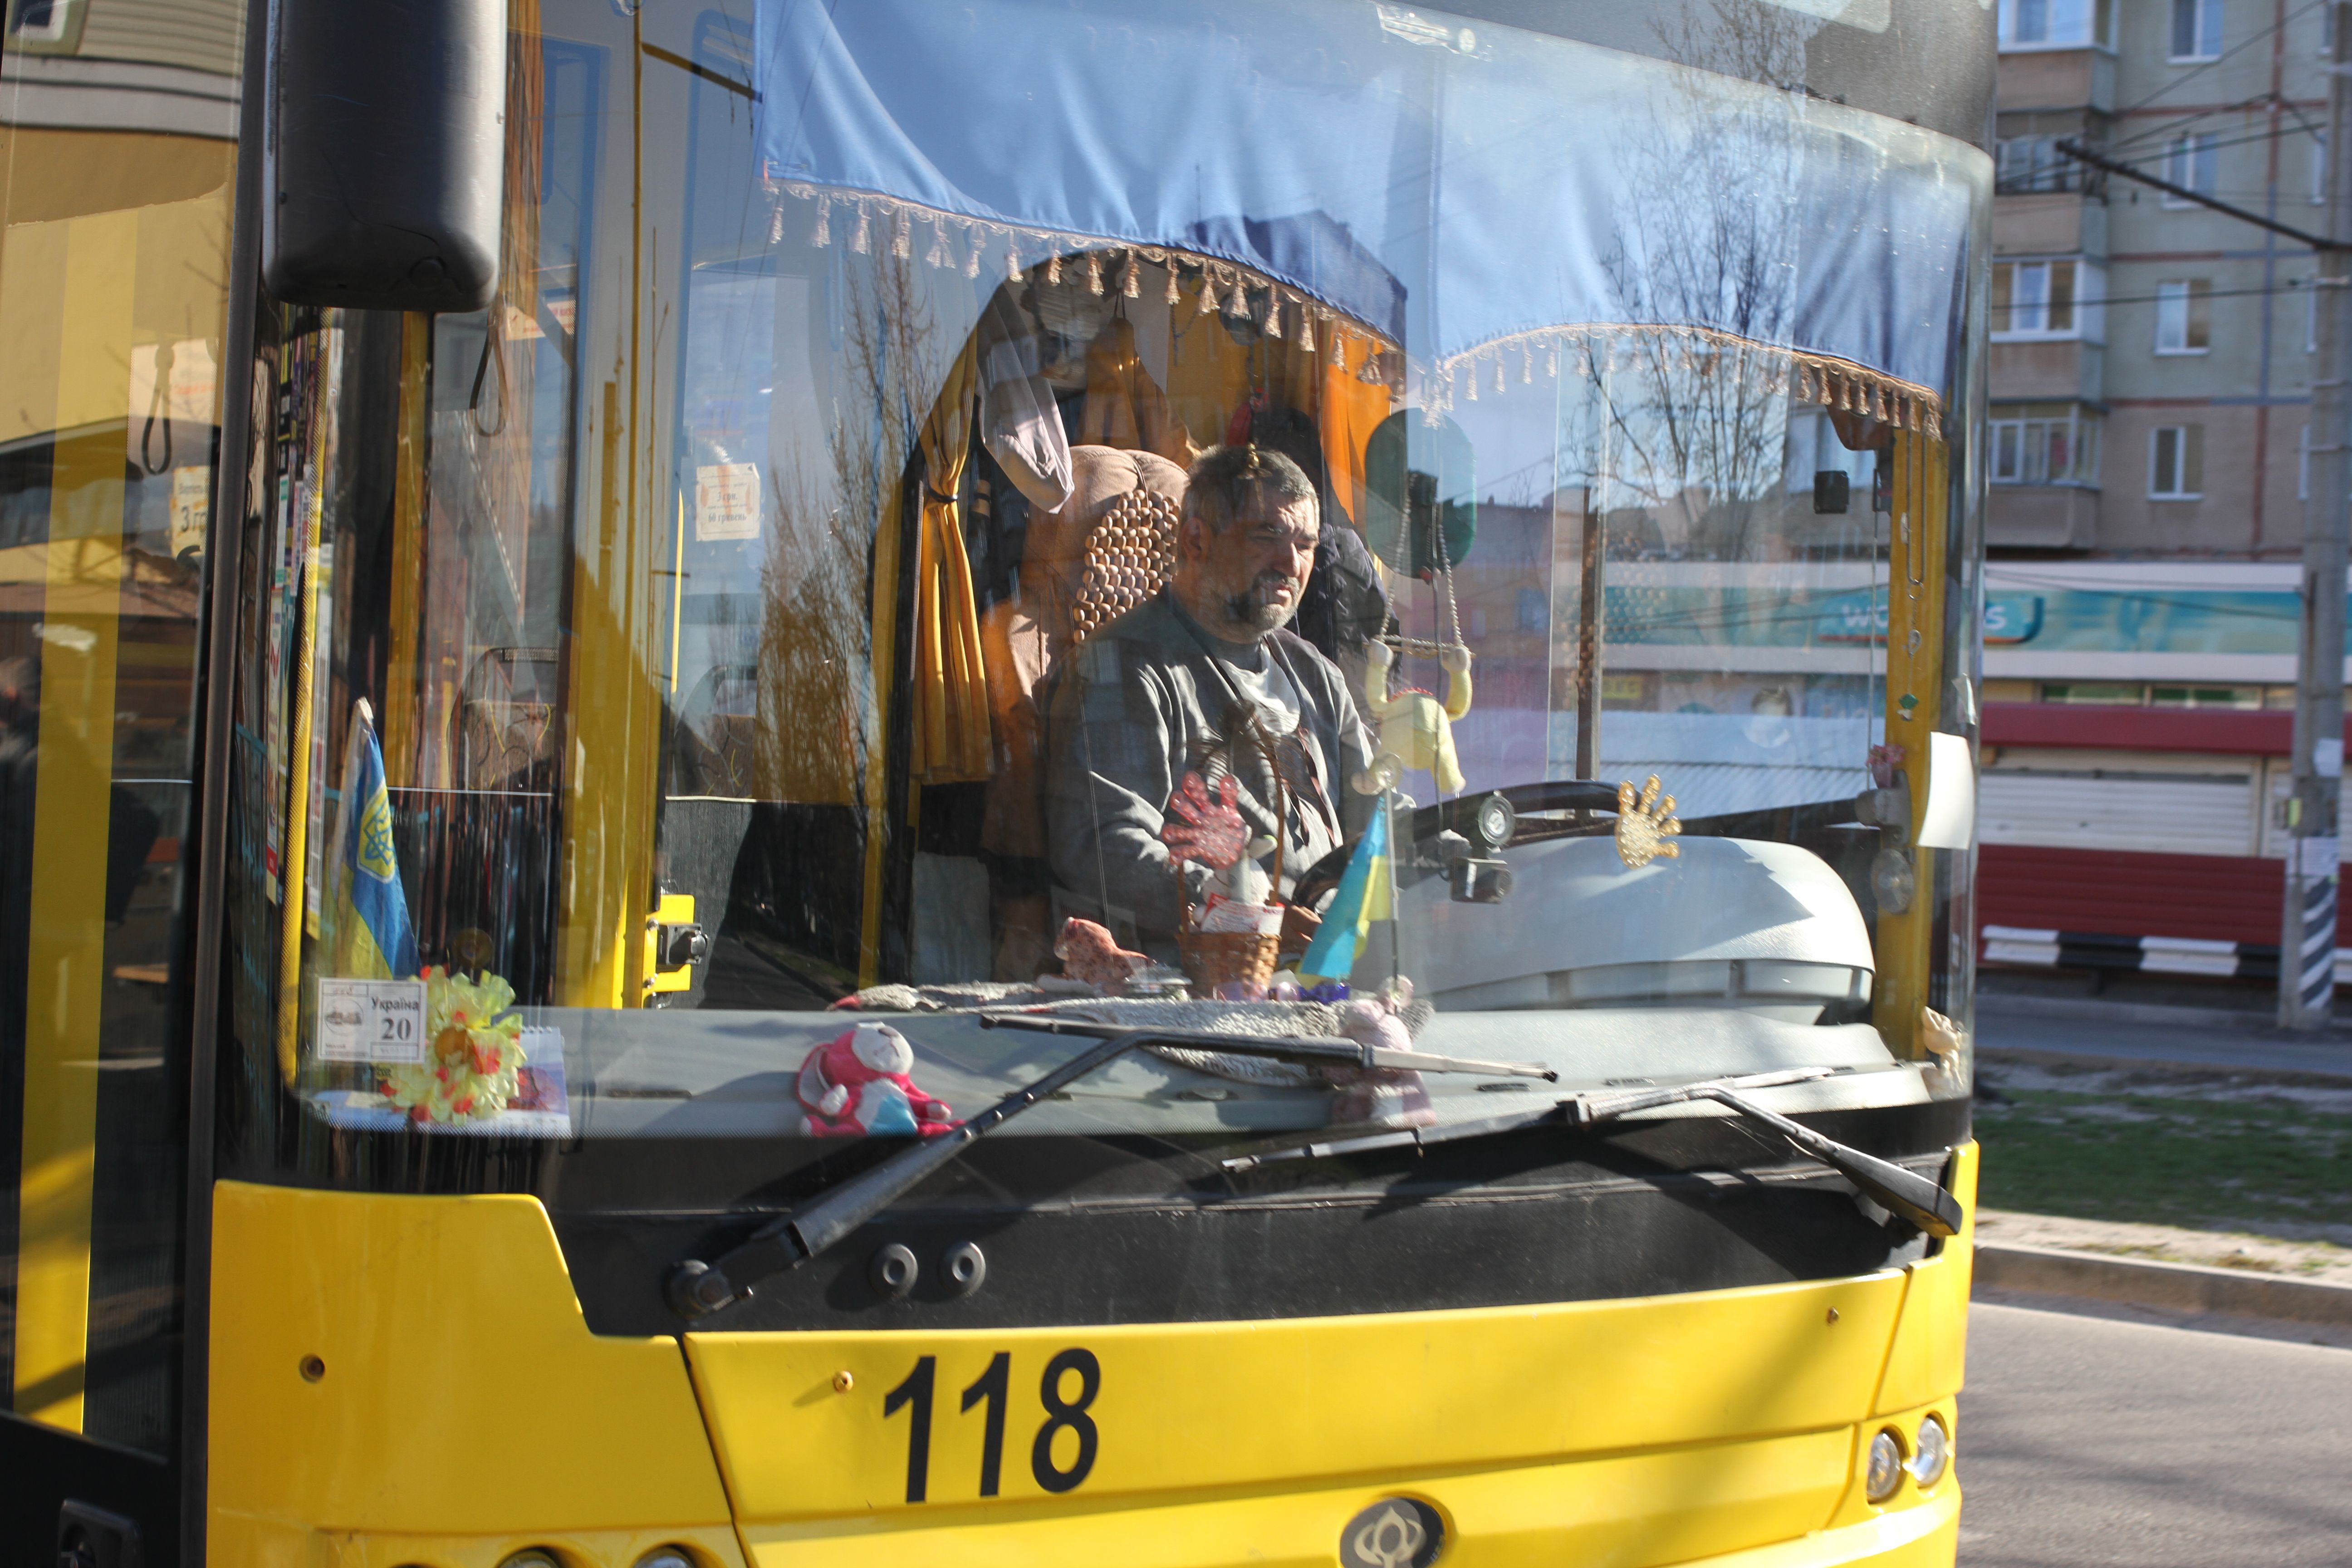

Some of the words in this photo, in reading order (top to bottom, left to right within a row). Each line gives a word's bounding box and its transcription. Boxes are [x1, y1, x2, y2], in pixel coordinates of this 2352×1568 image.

[372, 997, 419, 1013] Україна
[382, 1018, 411, 1040] 20
[883, 1347, 1101, 1504] 118
